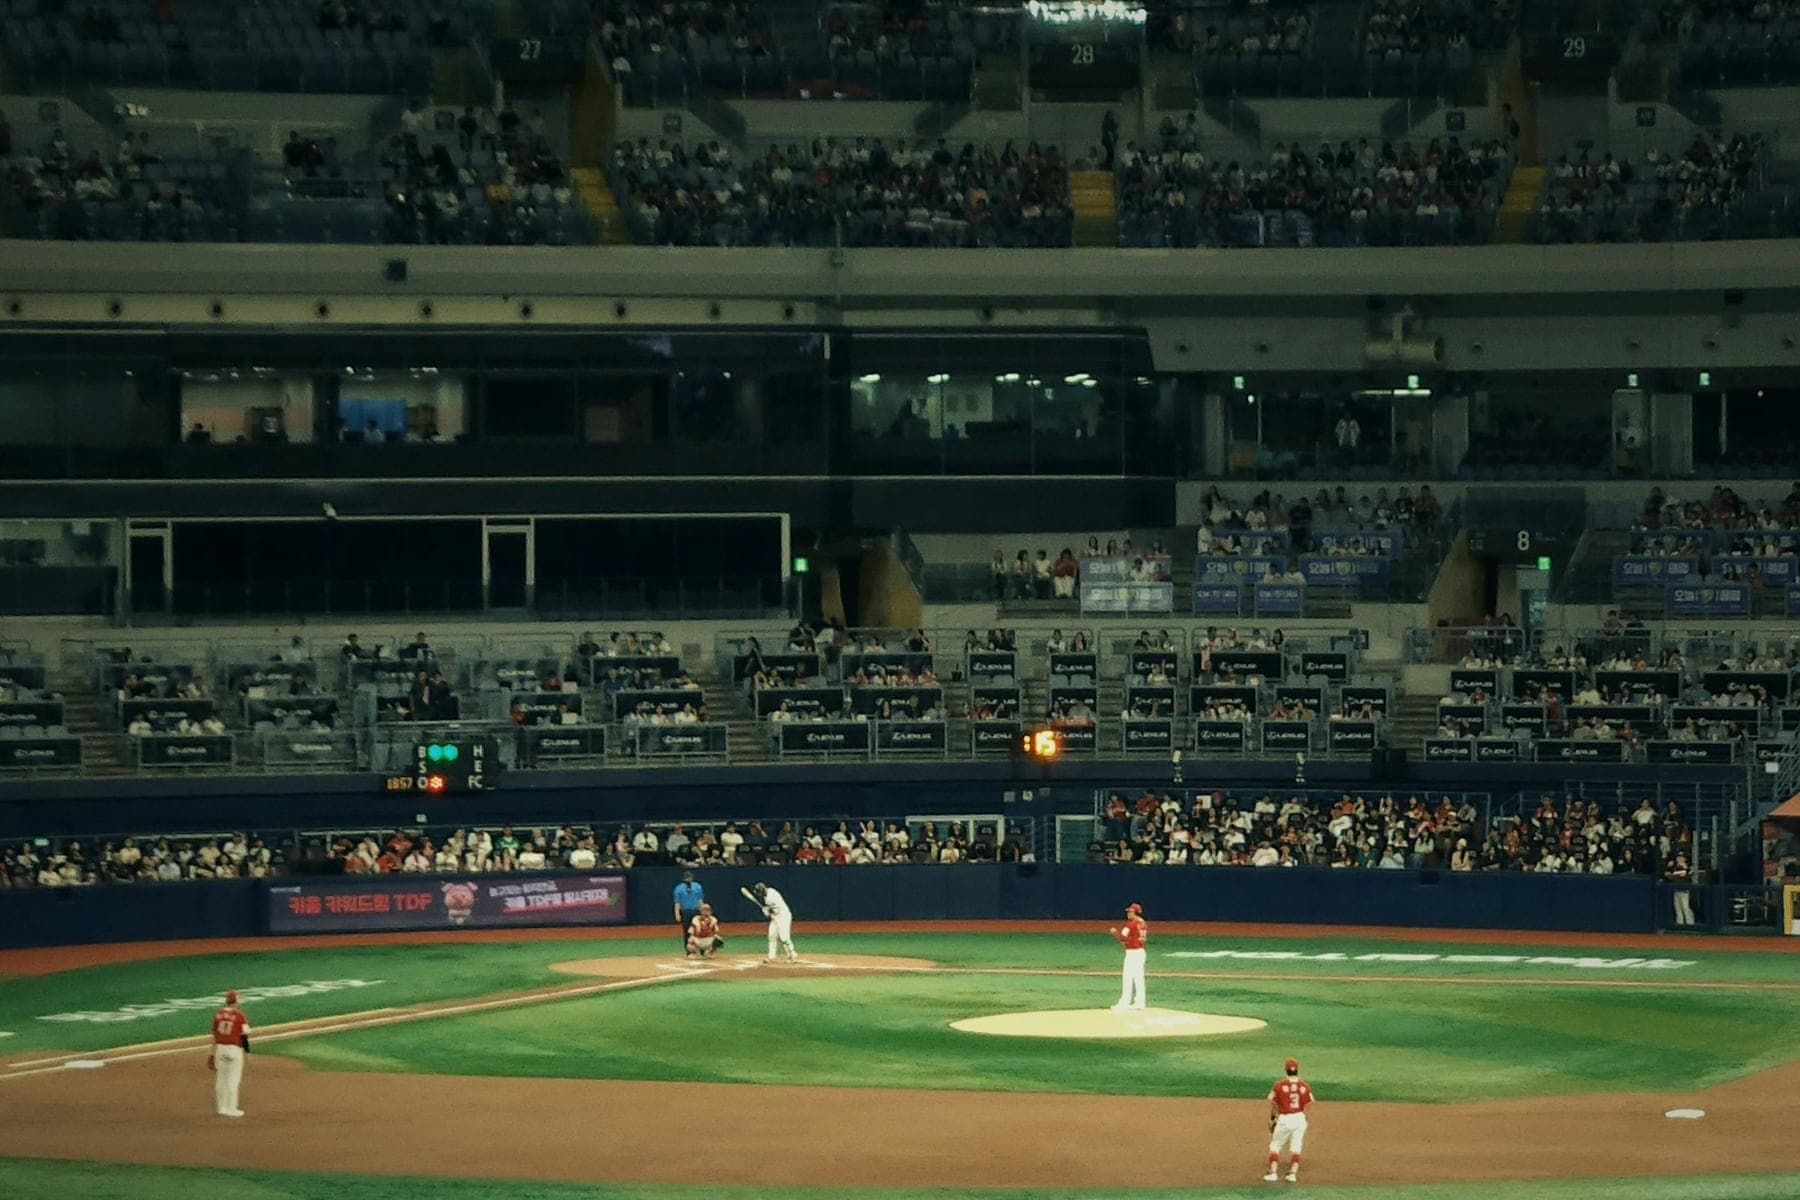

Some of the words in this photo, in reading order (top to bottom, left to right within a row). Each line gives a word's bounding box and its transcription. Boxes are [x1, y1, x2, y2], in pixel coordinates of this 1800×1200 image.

[520, 39, 542, 60] 27
[1071, 43, 1094, 64] 28
[1563, 37, 1586, 58] 29
[1517, 530, 1530, 551] 8
[1210, 731, 1240, 739] LEXUS
[418, 745, 427, 759] B
[473, 744, 485, 758] H
[418, 760, 427, 773] S
[474, 760, 484, 773] E
[468, 775, 483, 789] FC
[1289, 1093, 1300, 1109] 3
